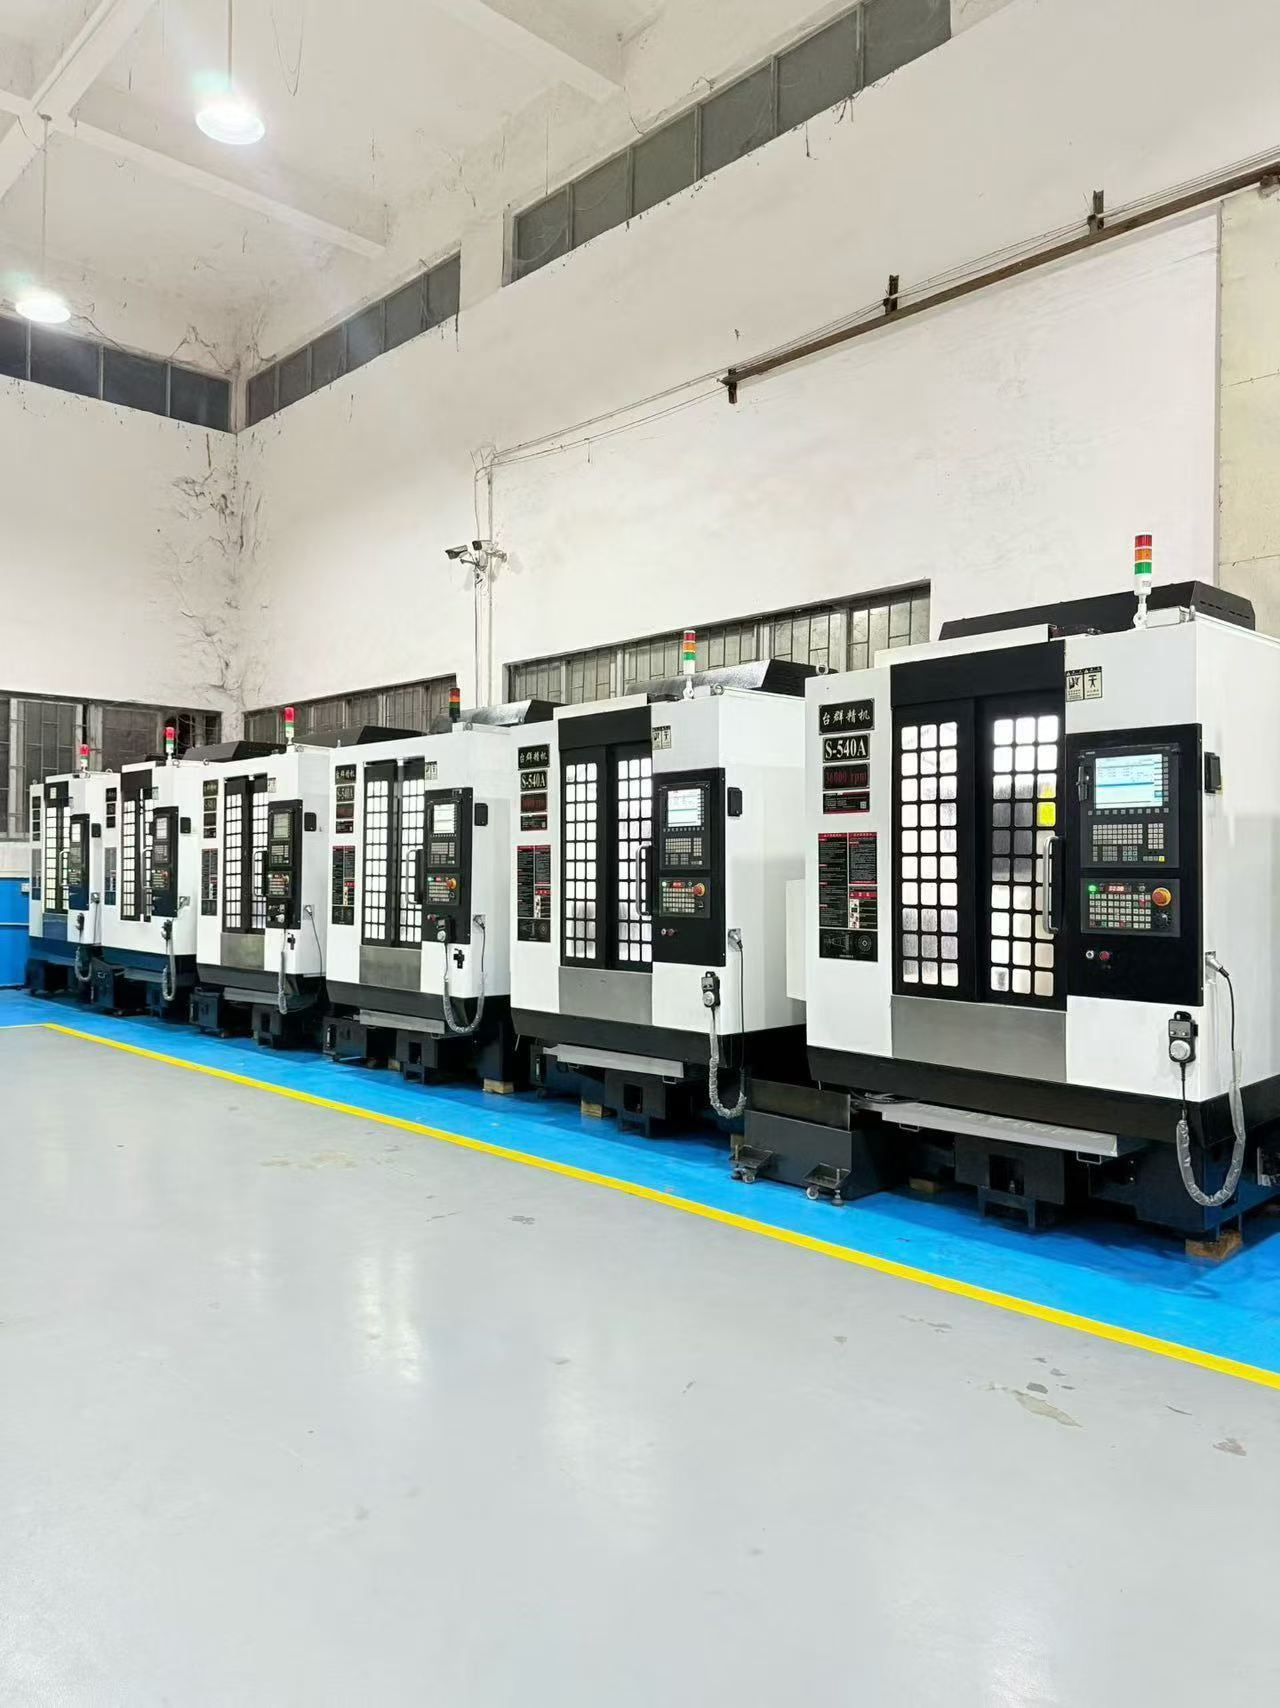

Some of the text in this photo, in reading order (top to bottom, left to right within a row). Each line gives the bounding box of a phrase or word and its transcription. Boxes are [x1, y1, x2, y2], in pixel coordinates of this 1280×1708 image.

[822, 708, 871, 726] 台群精机
[825, 738, 867, 759] S-540A
[521, 772, 546, 789] S-540A
